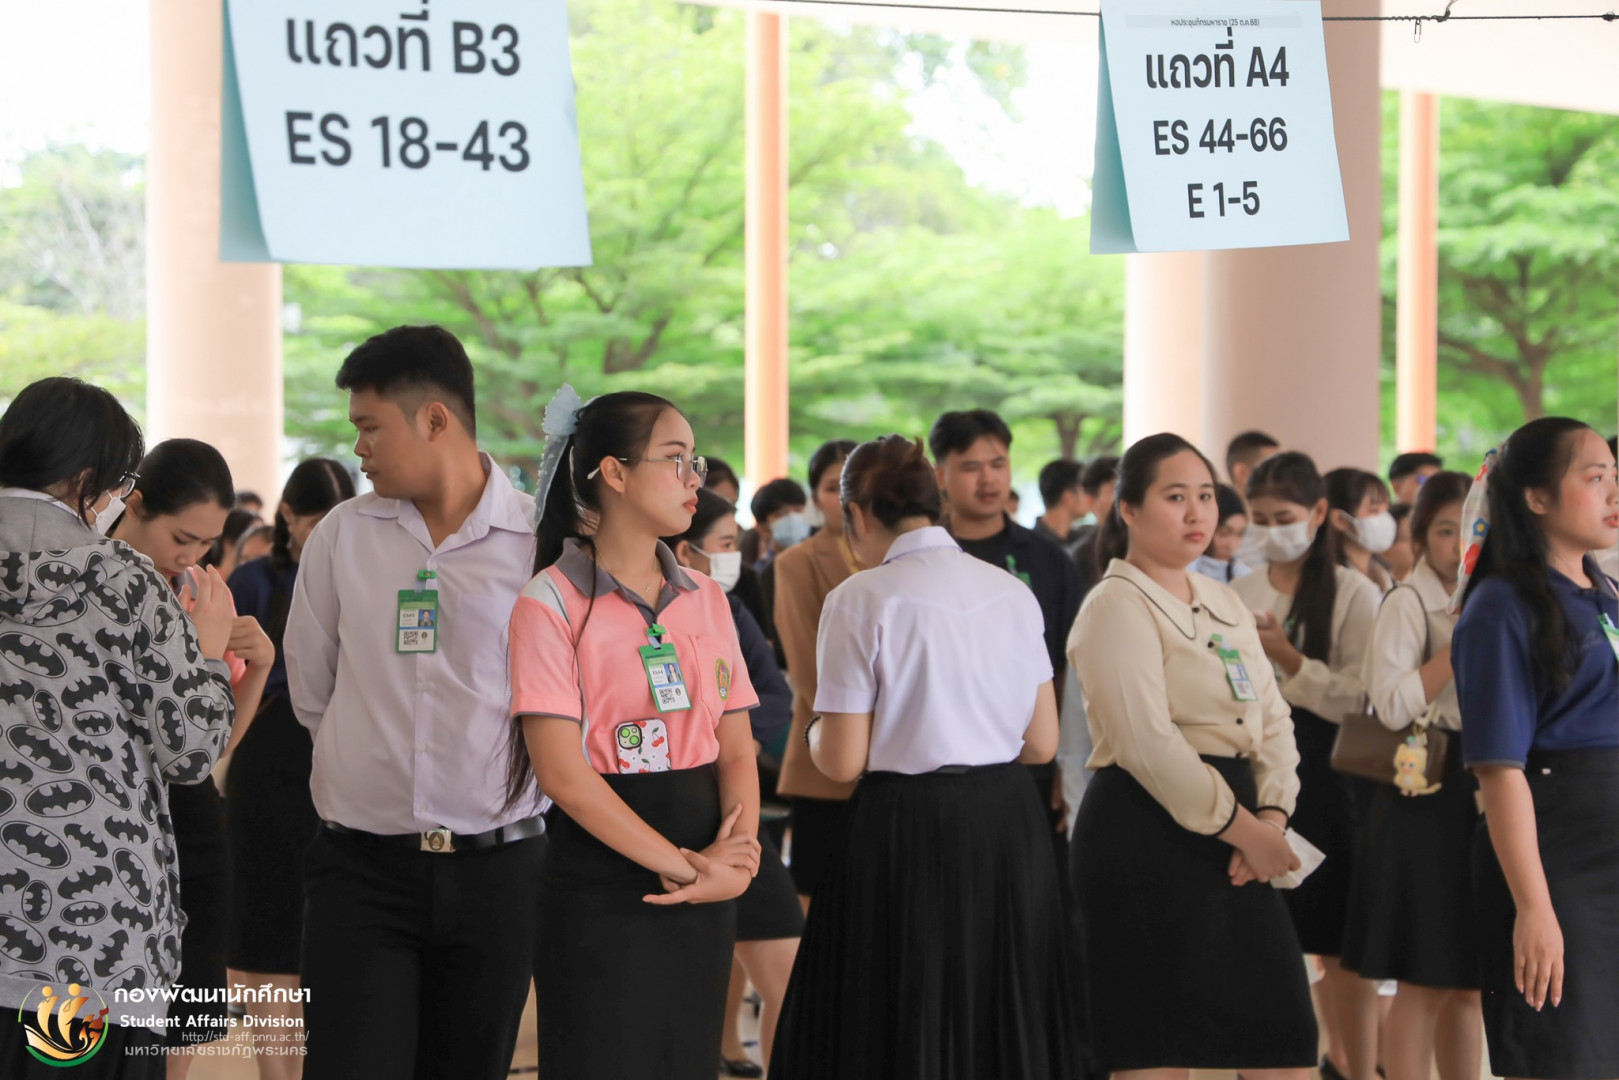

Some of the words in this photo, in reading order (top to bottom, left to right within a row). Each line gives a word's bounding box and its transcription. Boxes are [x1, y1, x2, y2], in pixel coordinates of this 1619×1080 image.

[452, 21, 521, 77] B3
[1145, 27, 1235, 89] แถวที่
[1246, 46, 1290, 88] A4
[285, 111, 352, 167] ES
[371, 116, 530, 173] 18-43
[1153, 119, 1190, 156] ES
[1198, 116, 1288, 154] 44-66
[1187, 183, 1205, 219] E
[1213, 180, 1260, 217] 1-5
